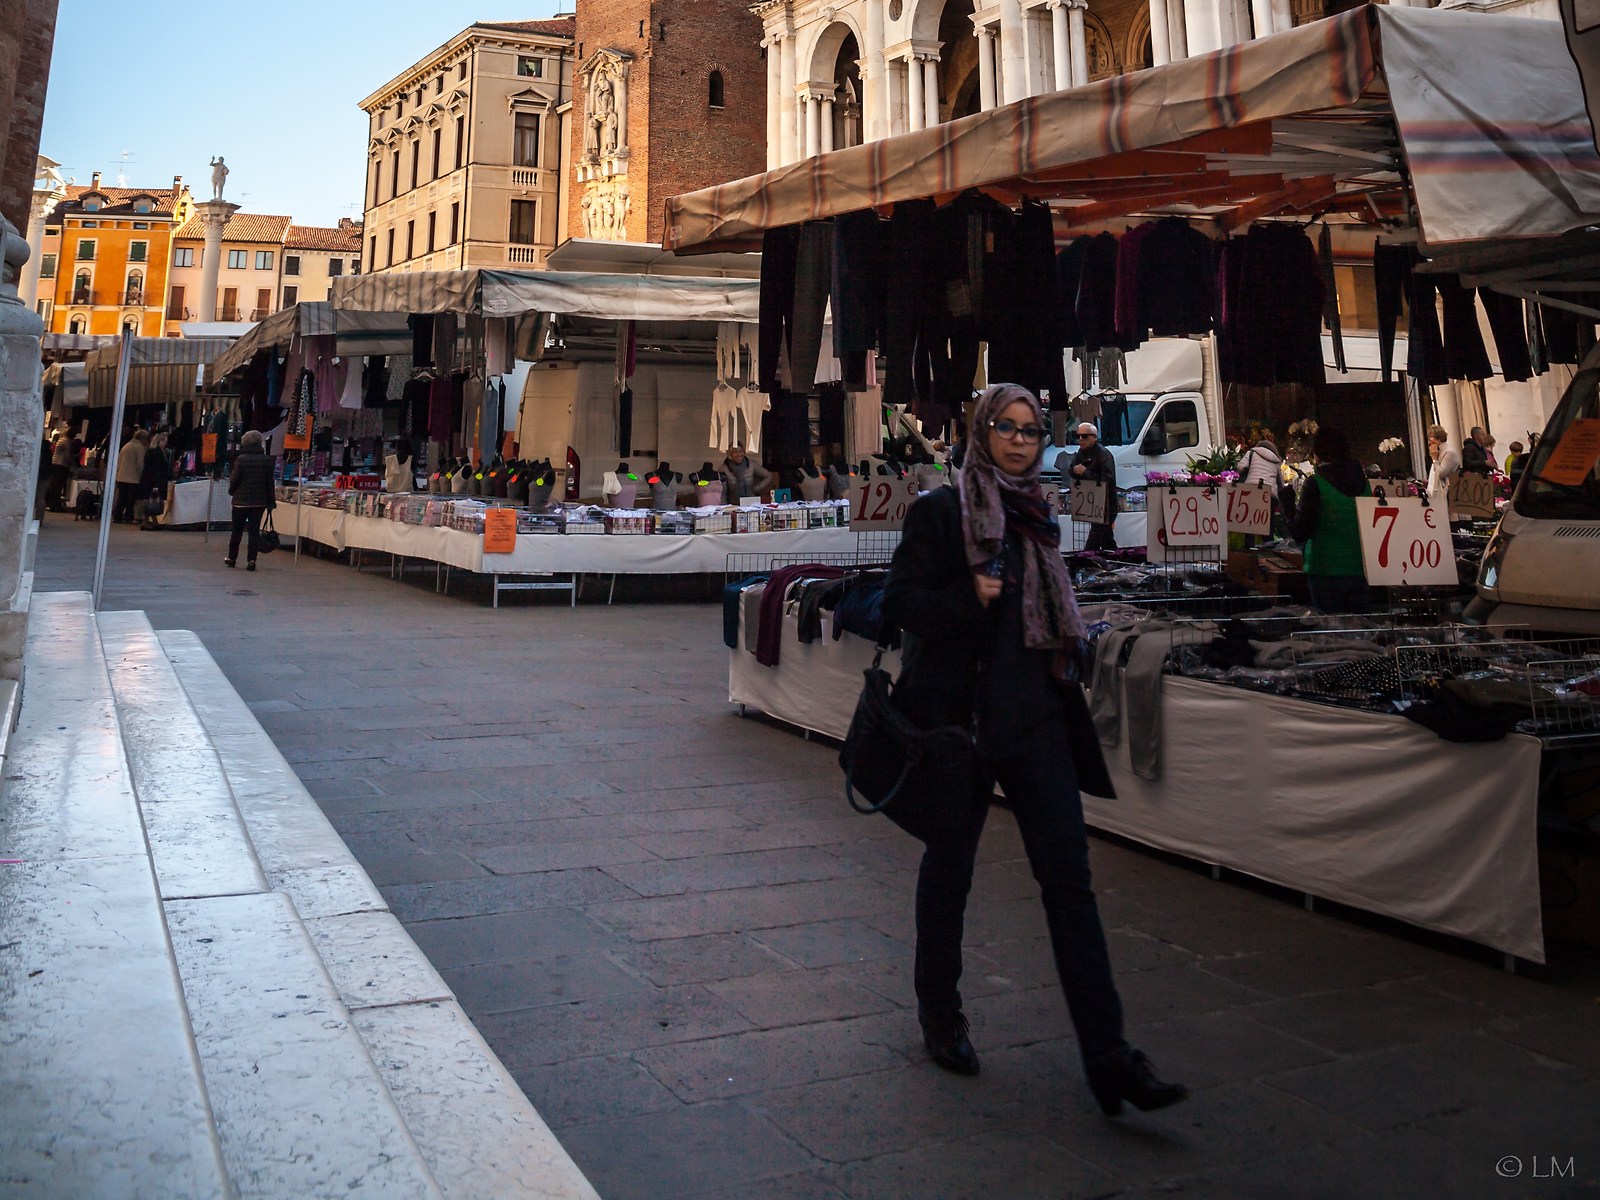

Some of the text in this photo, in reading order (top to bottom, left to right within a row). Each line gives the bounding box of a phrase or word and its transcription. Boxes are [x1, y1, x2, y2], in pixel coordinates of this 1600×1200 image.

[853, 482, 911, 523] 12,0
[1169, 497, 1219, 537] 29,00
[1227, 490, 1269, 526] 15,00
[1372, 507, 1441, 573] 7,00 €
